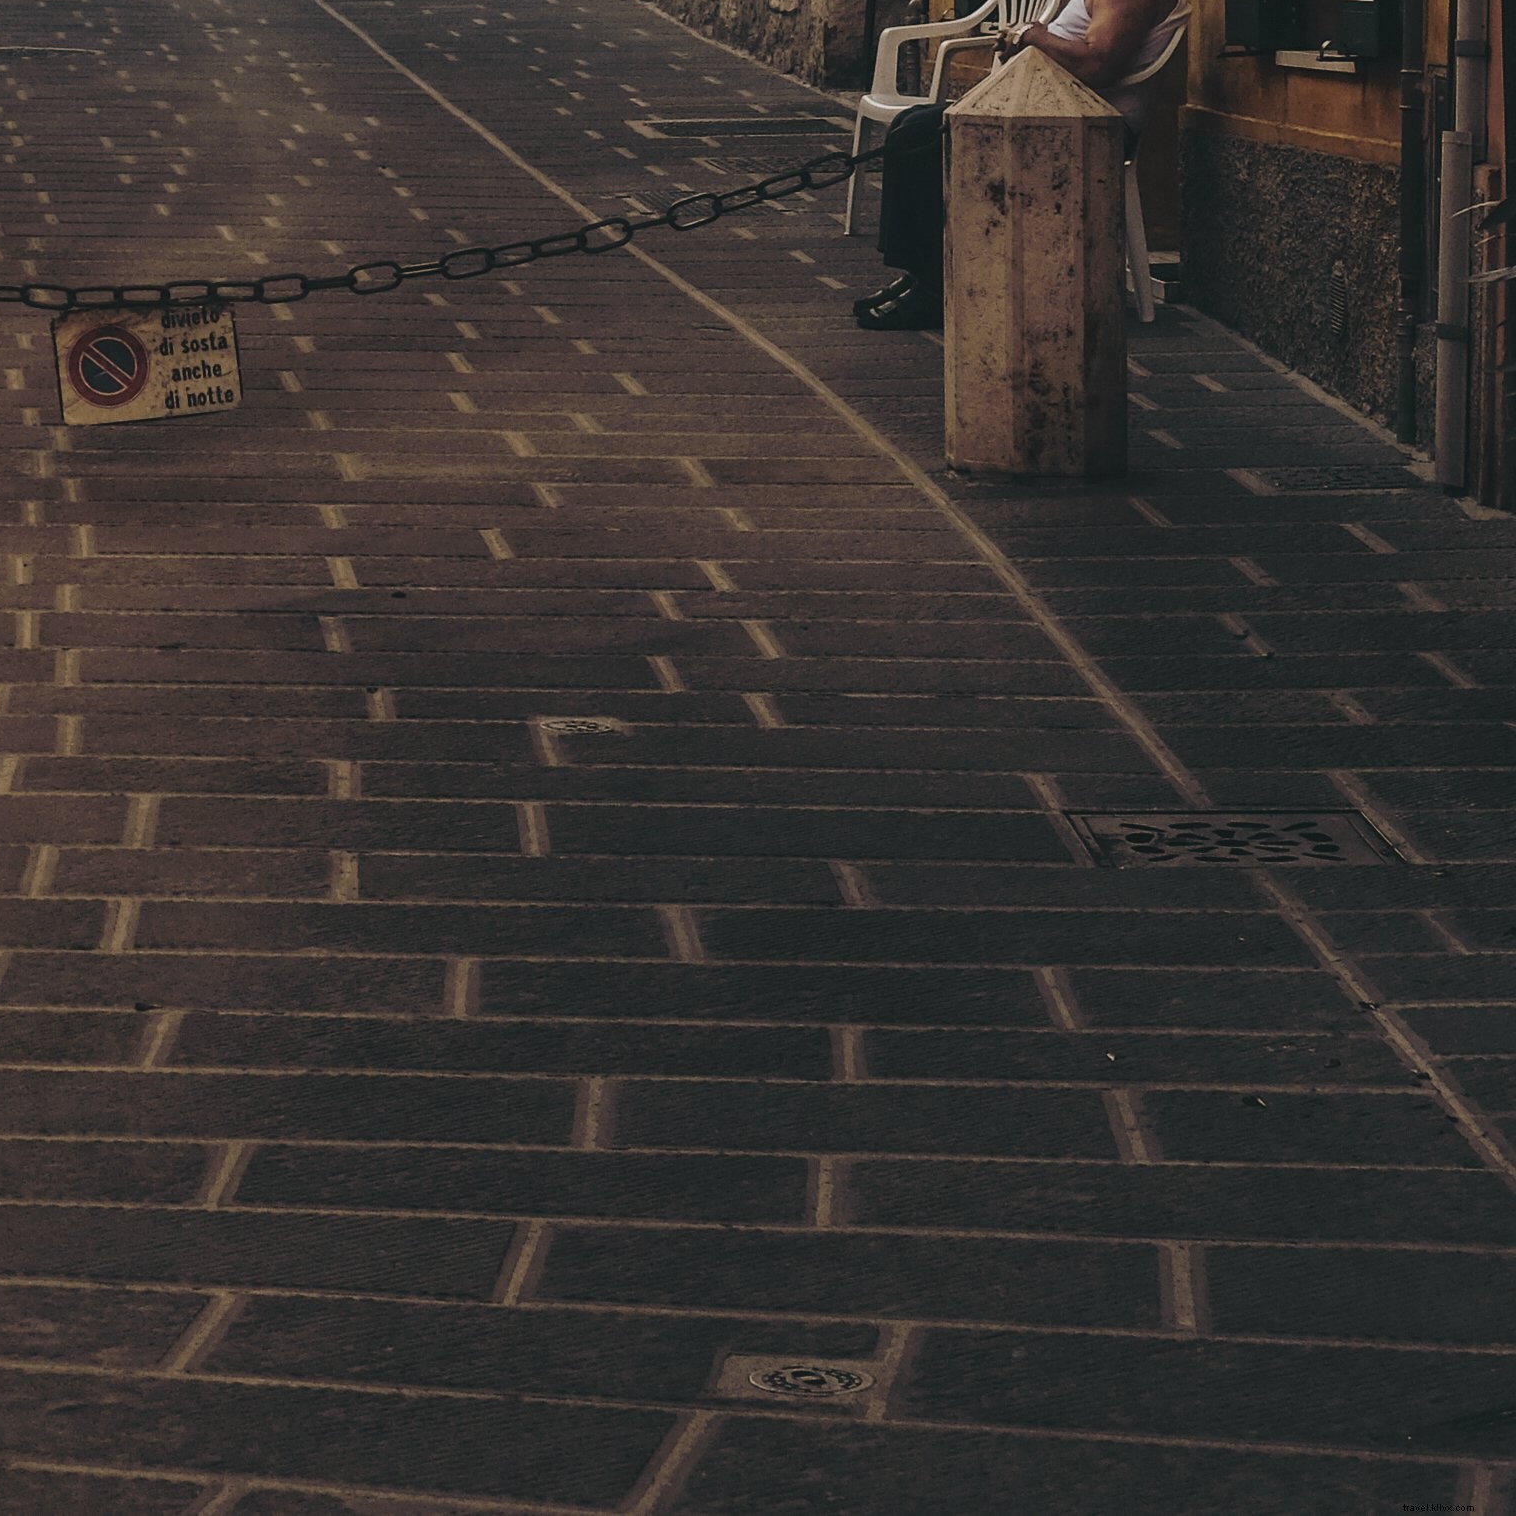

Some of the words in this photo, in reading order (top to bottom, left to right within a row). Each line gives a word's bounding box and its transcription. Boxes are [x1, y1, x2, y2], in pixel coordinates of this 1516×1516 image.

[161, 308, 220, 328] divieto
[159, 337, 174, 356] di
[181, 331, 228, 354] sosta
[171, 360, 222, 382] anche
[165, 389, 180, 409] di
[187, 386, 234, 407] notte
